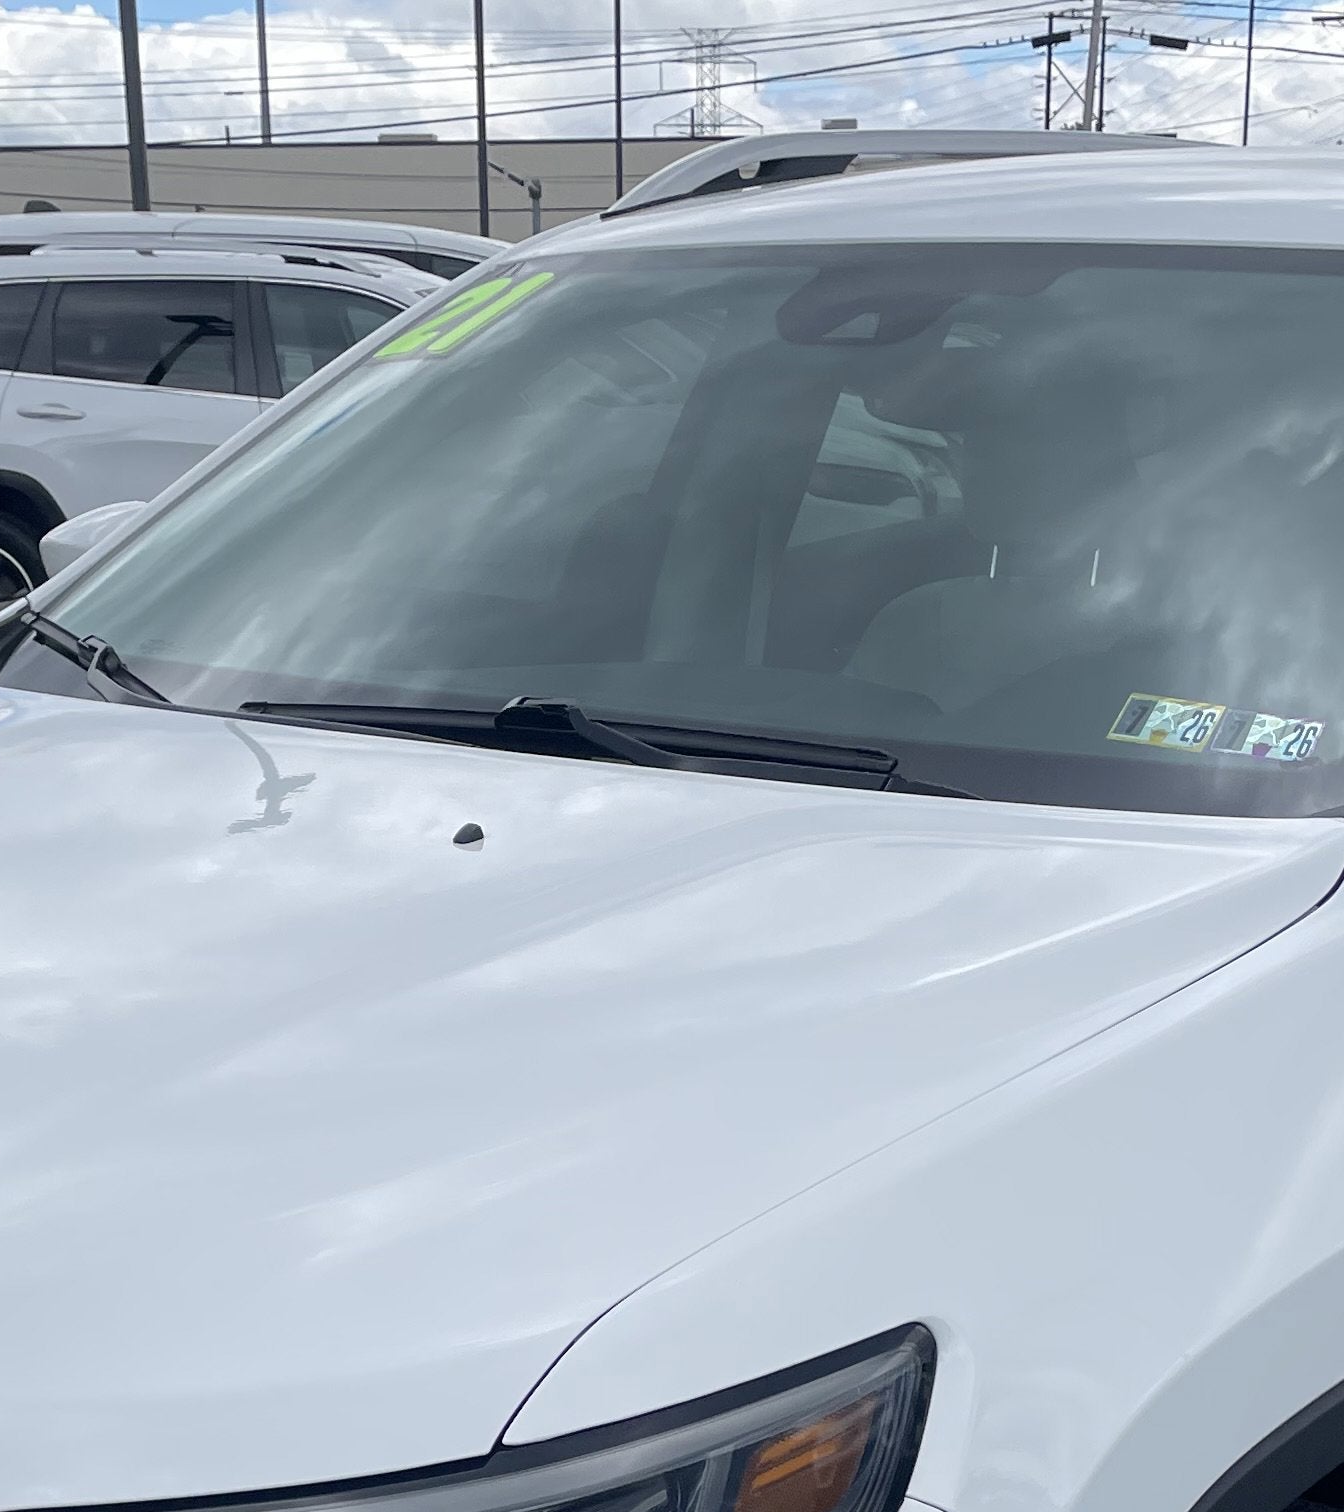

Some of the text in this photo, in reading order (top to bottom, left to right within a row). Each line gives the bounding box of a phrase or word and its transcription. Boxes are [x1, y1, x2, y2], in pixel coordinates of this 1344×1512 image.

[372, 271, 555, 360] 21
[1179, 709, 1217, 744] 26
[1282, 724, 1319, 759] 26
